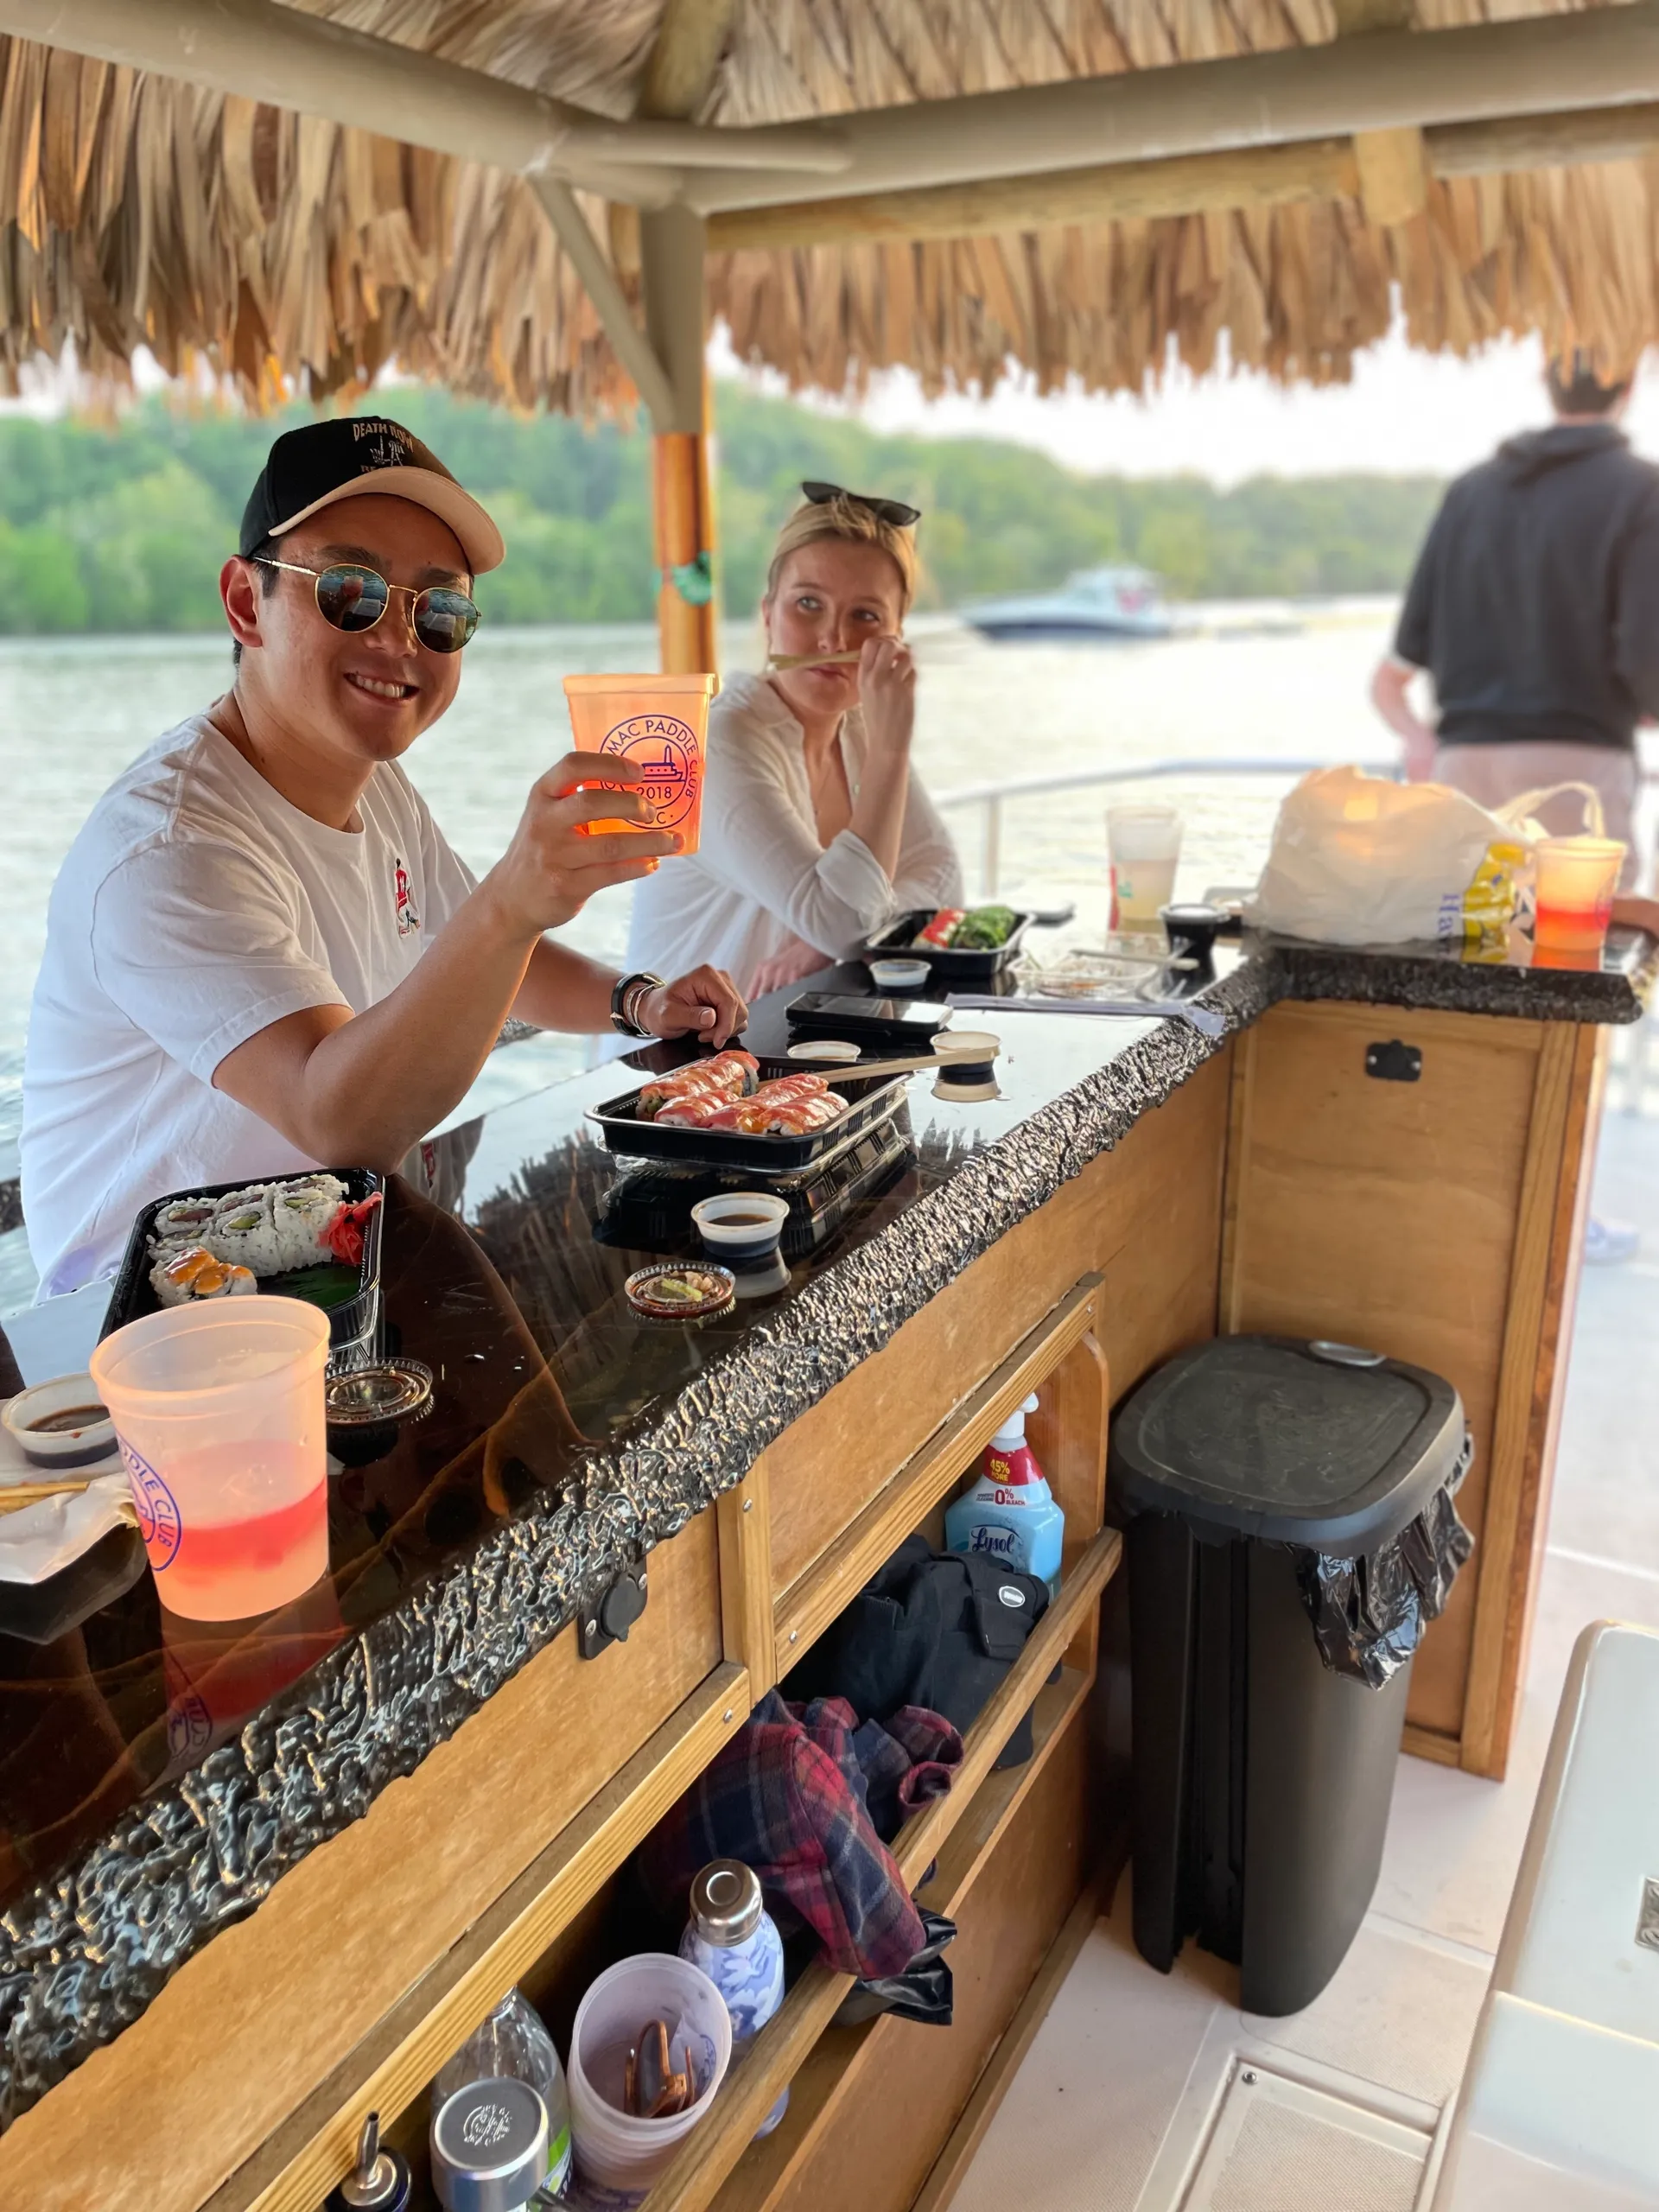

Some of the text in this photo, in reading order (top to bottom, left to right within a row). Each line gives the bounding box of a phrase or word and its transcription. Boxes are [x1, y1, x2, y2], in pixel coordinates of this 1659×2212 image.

[353, 423, 414, 453] DEATH ROW
[645, 720, 696, 756] PADDLE
[685, 760, 698, 798] CLUB
[637, 786, 672, 799] 2018
[154, 1499, 175, 1548] CLUB
[970, 1527, 1015, 1554] Lysol
